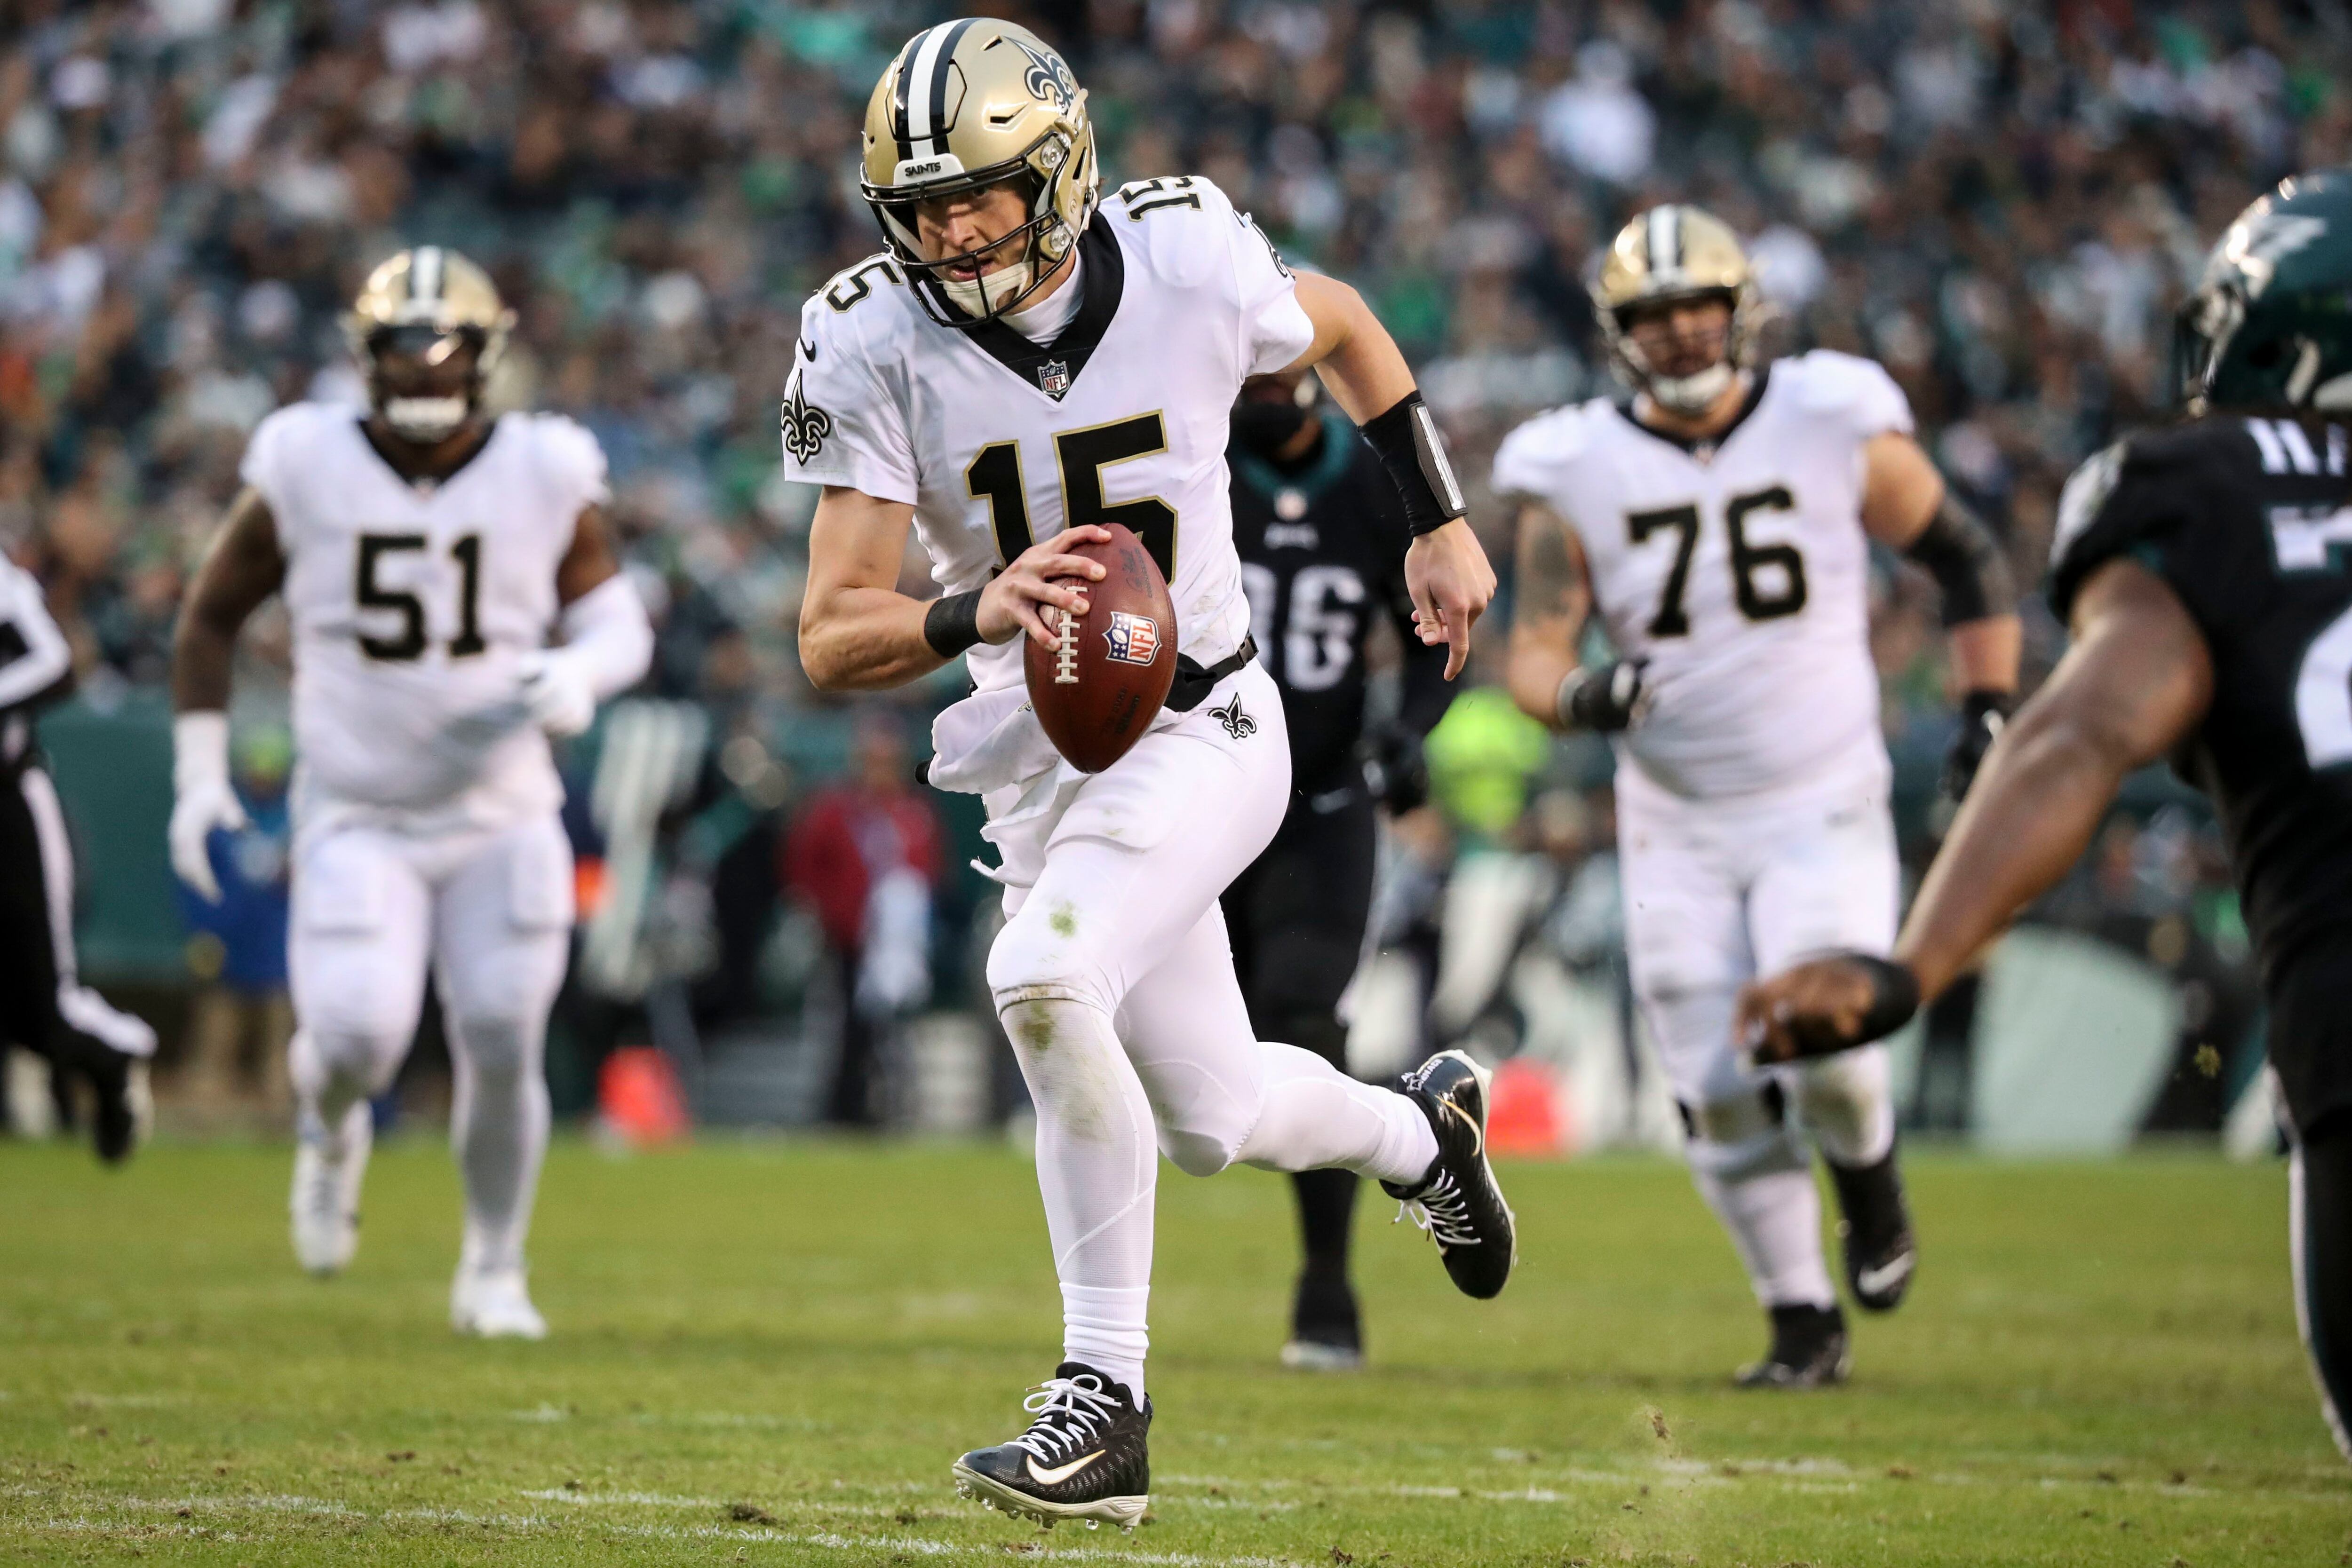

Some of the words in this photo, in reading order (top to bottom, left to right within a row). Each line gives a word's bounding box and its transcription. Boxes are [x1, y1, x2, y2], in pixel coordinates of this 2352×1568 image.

[905, 162, 941, 176] SAINTS
[1045, 376, 1066, 390] NFL
[962, 409, 1178, 587] 15
[356, 531, 487, 661] 51
[1625, 484, 1809, 639] 76
[1129, 623, 1155, 660] NFL
